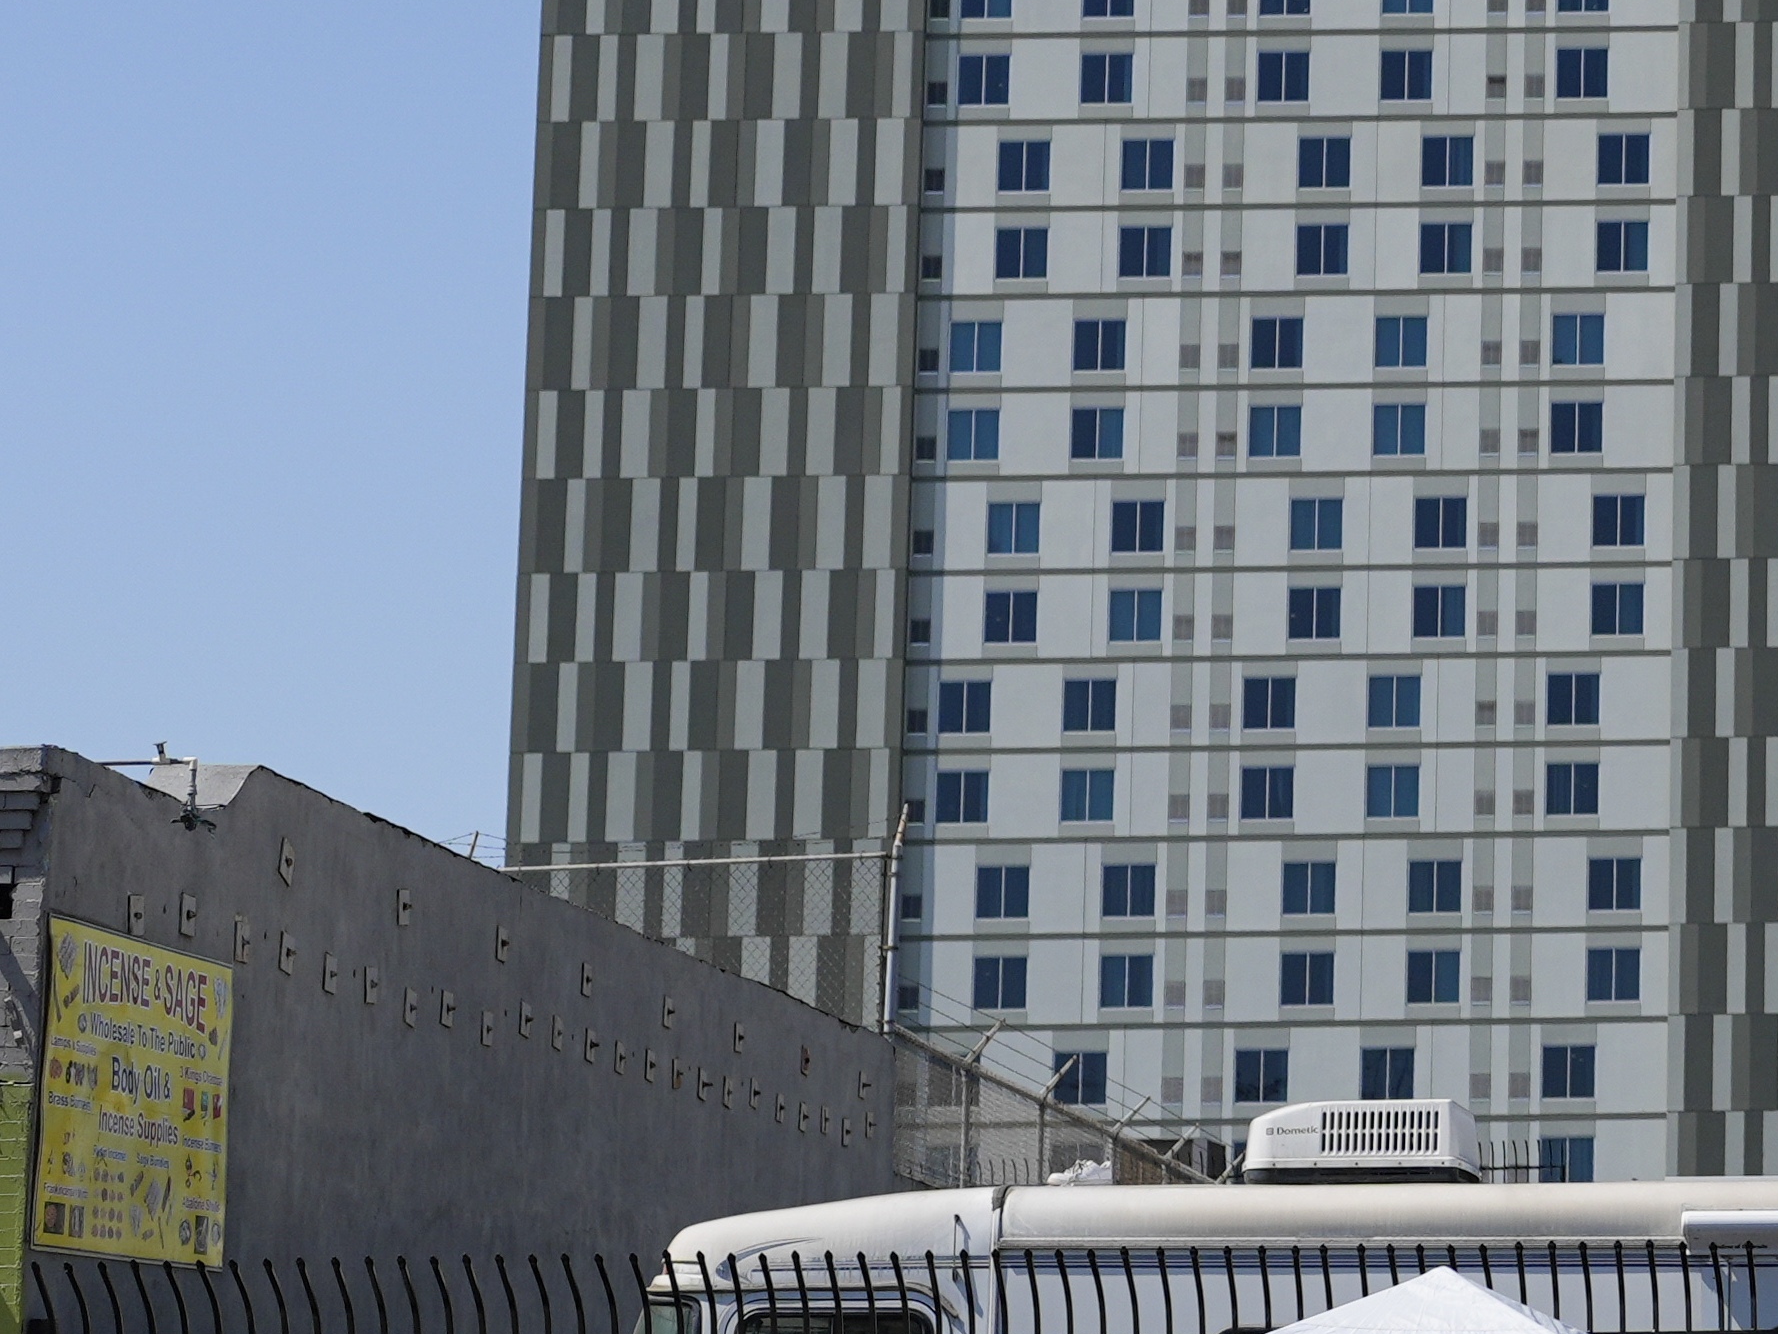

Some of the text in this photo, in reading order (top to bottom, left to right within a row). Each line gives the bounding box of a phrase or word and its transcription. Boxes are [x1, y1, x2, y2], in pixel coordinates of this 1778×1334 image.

[83, 941, 208, 1034] INCENSE & SAGE
[91, 1013, 195, 1058] Wholesale To The Public
[48, 1091, 68, 1106] Brass
[112, 1056, 171, 1104] Body Oil &
[99, 1105, 178, 1148] Incense Supplies
[1277, 1126, 1319, 1135] Dometic
